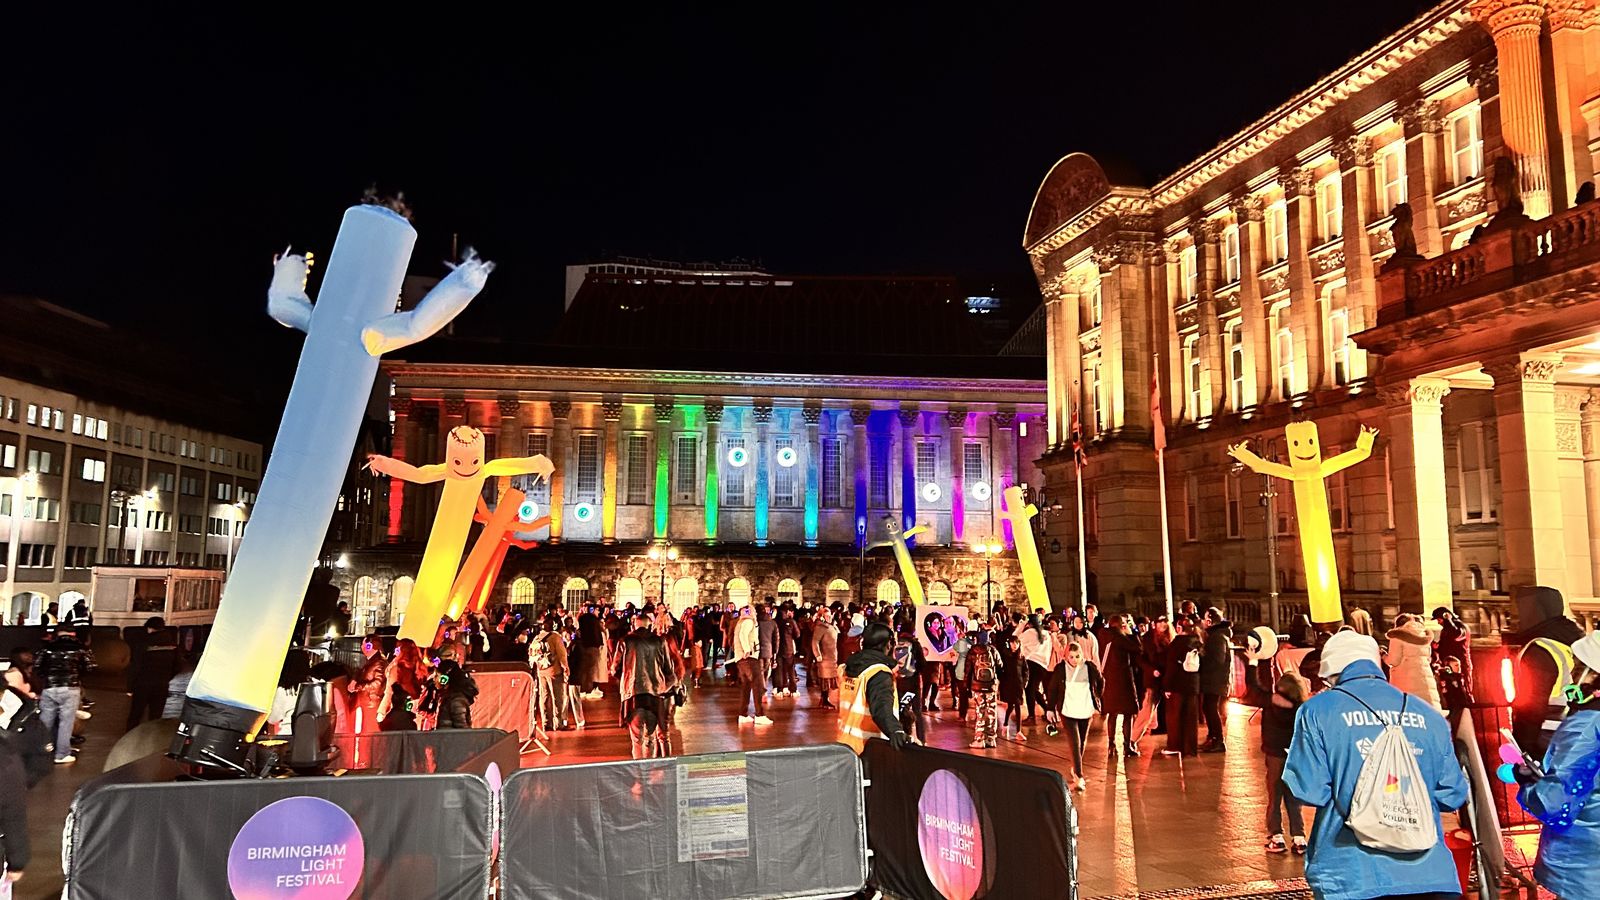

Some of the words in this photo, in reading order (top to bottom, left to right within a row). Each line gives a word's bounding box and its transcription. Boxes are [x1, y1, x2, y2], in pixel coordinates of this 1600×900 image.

[1341, 709, 1427, 731] VOLUNTEER
[925, 814, 974, 838] BIRMINGHAM
[247, 844, 346, 860] BIRMINGHAM
[952, 836, 974, 853] LIGHT
[301, 858, 345, 872] LIGHT
[941, 848, 975, 869] FESTIVAL
[276, 873, 344, 888] FESTIVAL
